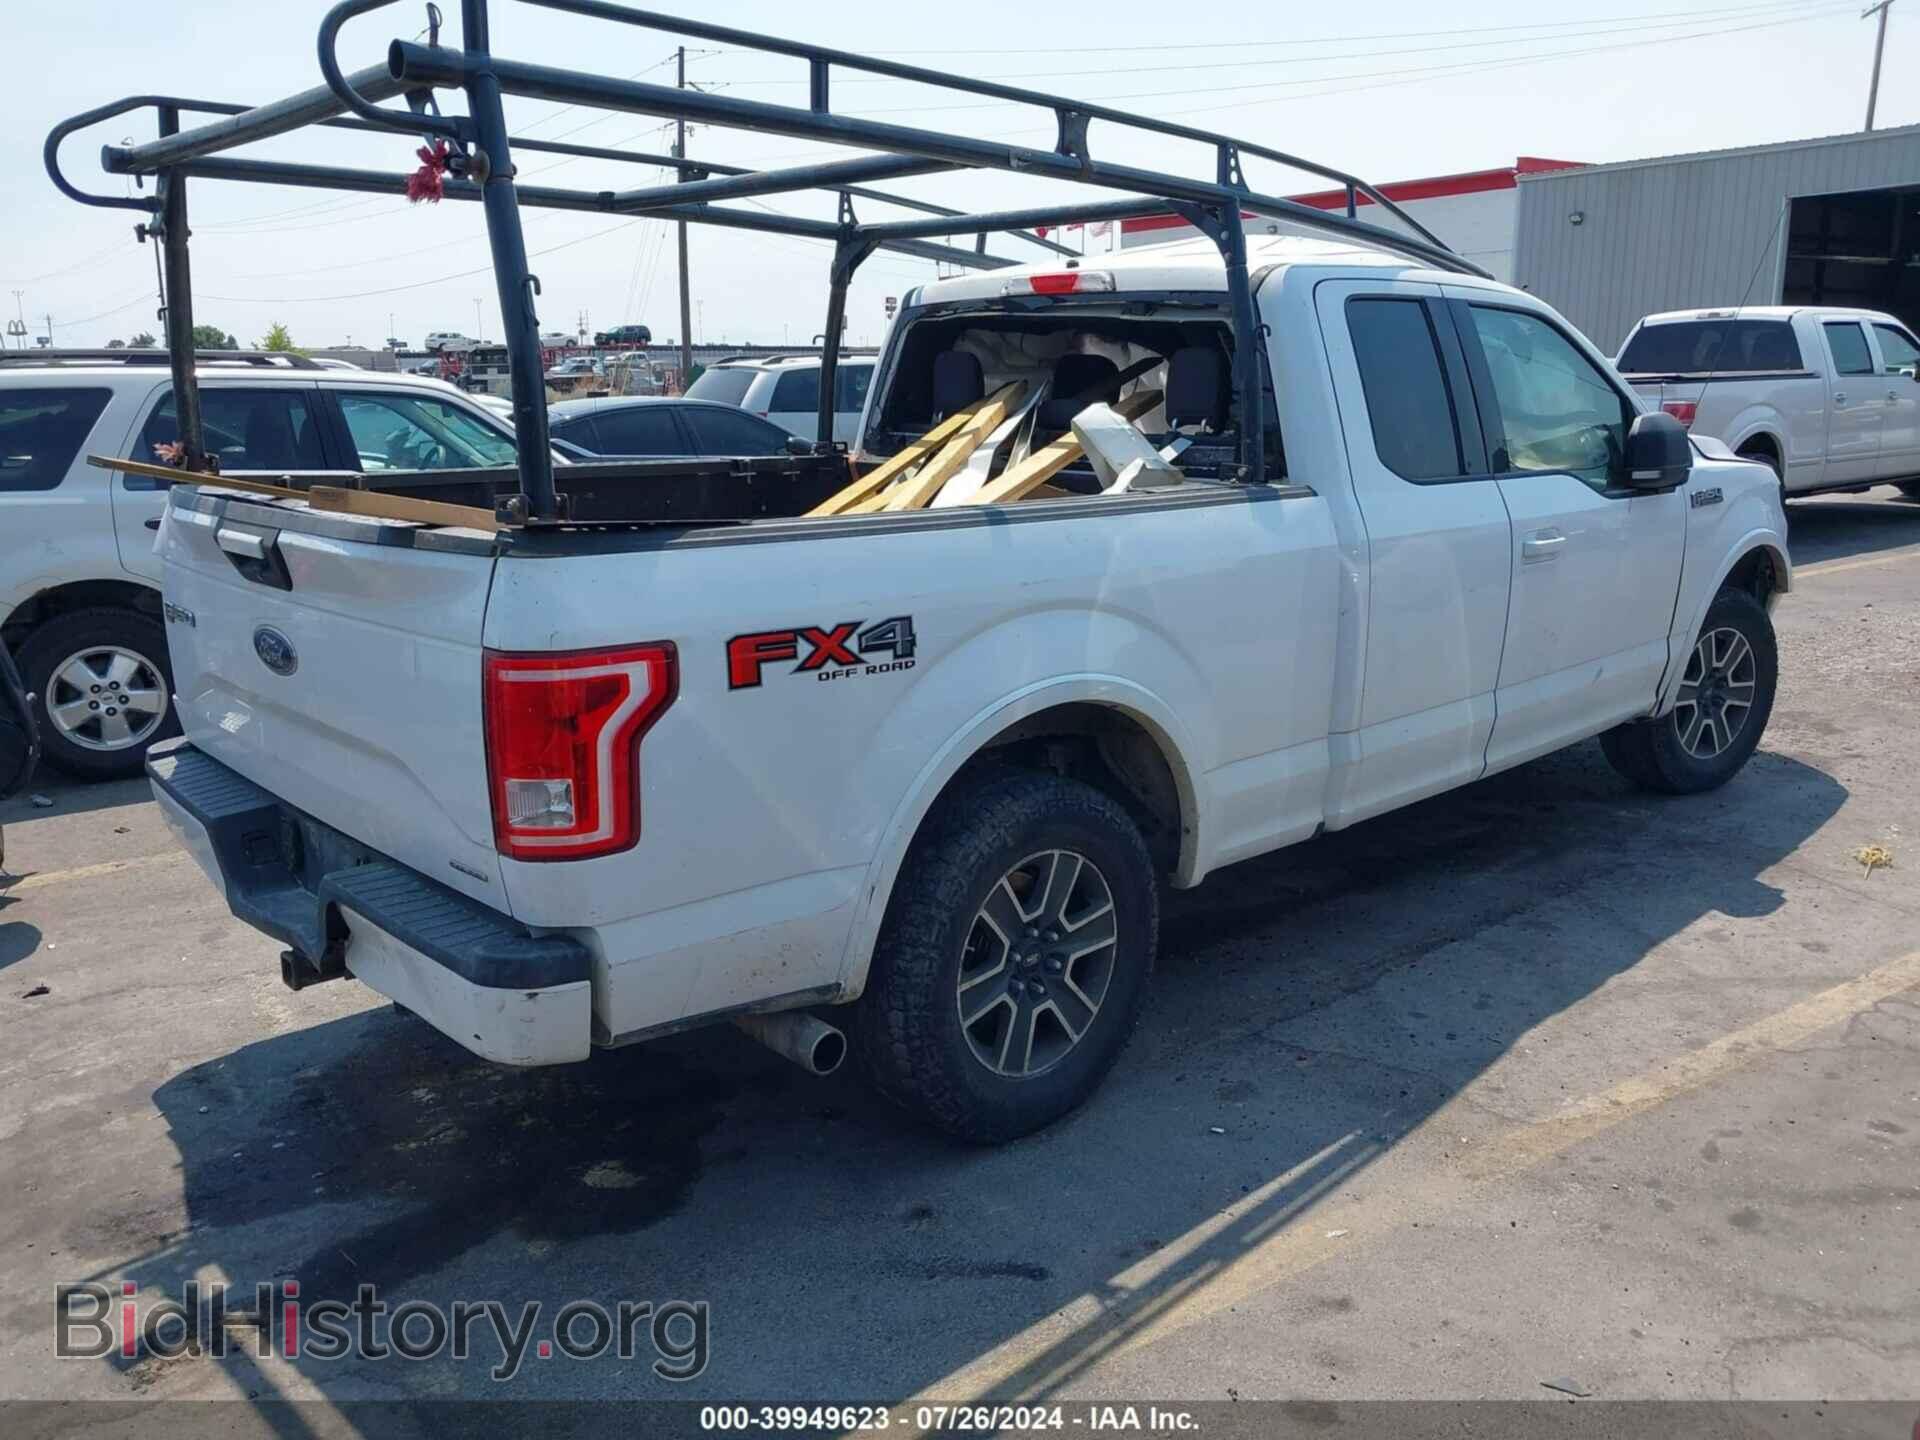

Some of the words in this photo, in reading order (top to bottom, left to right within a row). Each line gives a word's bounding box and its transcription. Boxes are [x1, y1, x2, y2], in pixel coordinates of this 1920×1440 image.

[726, 614, 917, 692] FX4
[817, 666, 859, 682] OFF
[865, 659, 917, 676] ROAD
